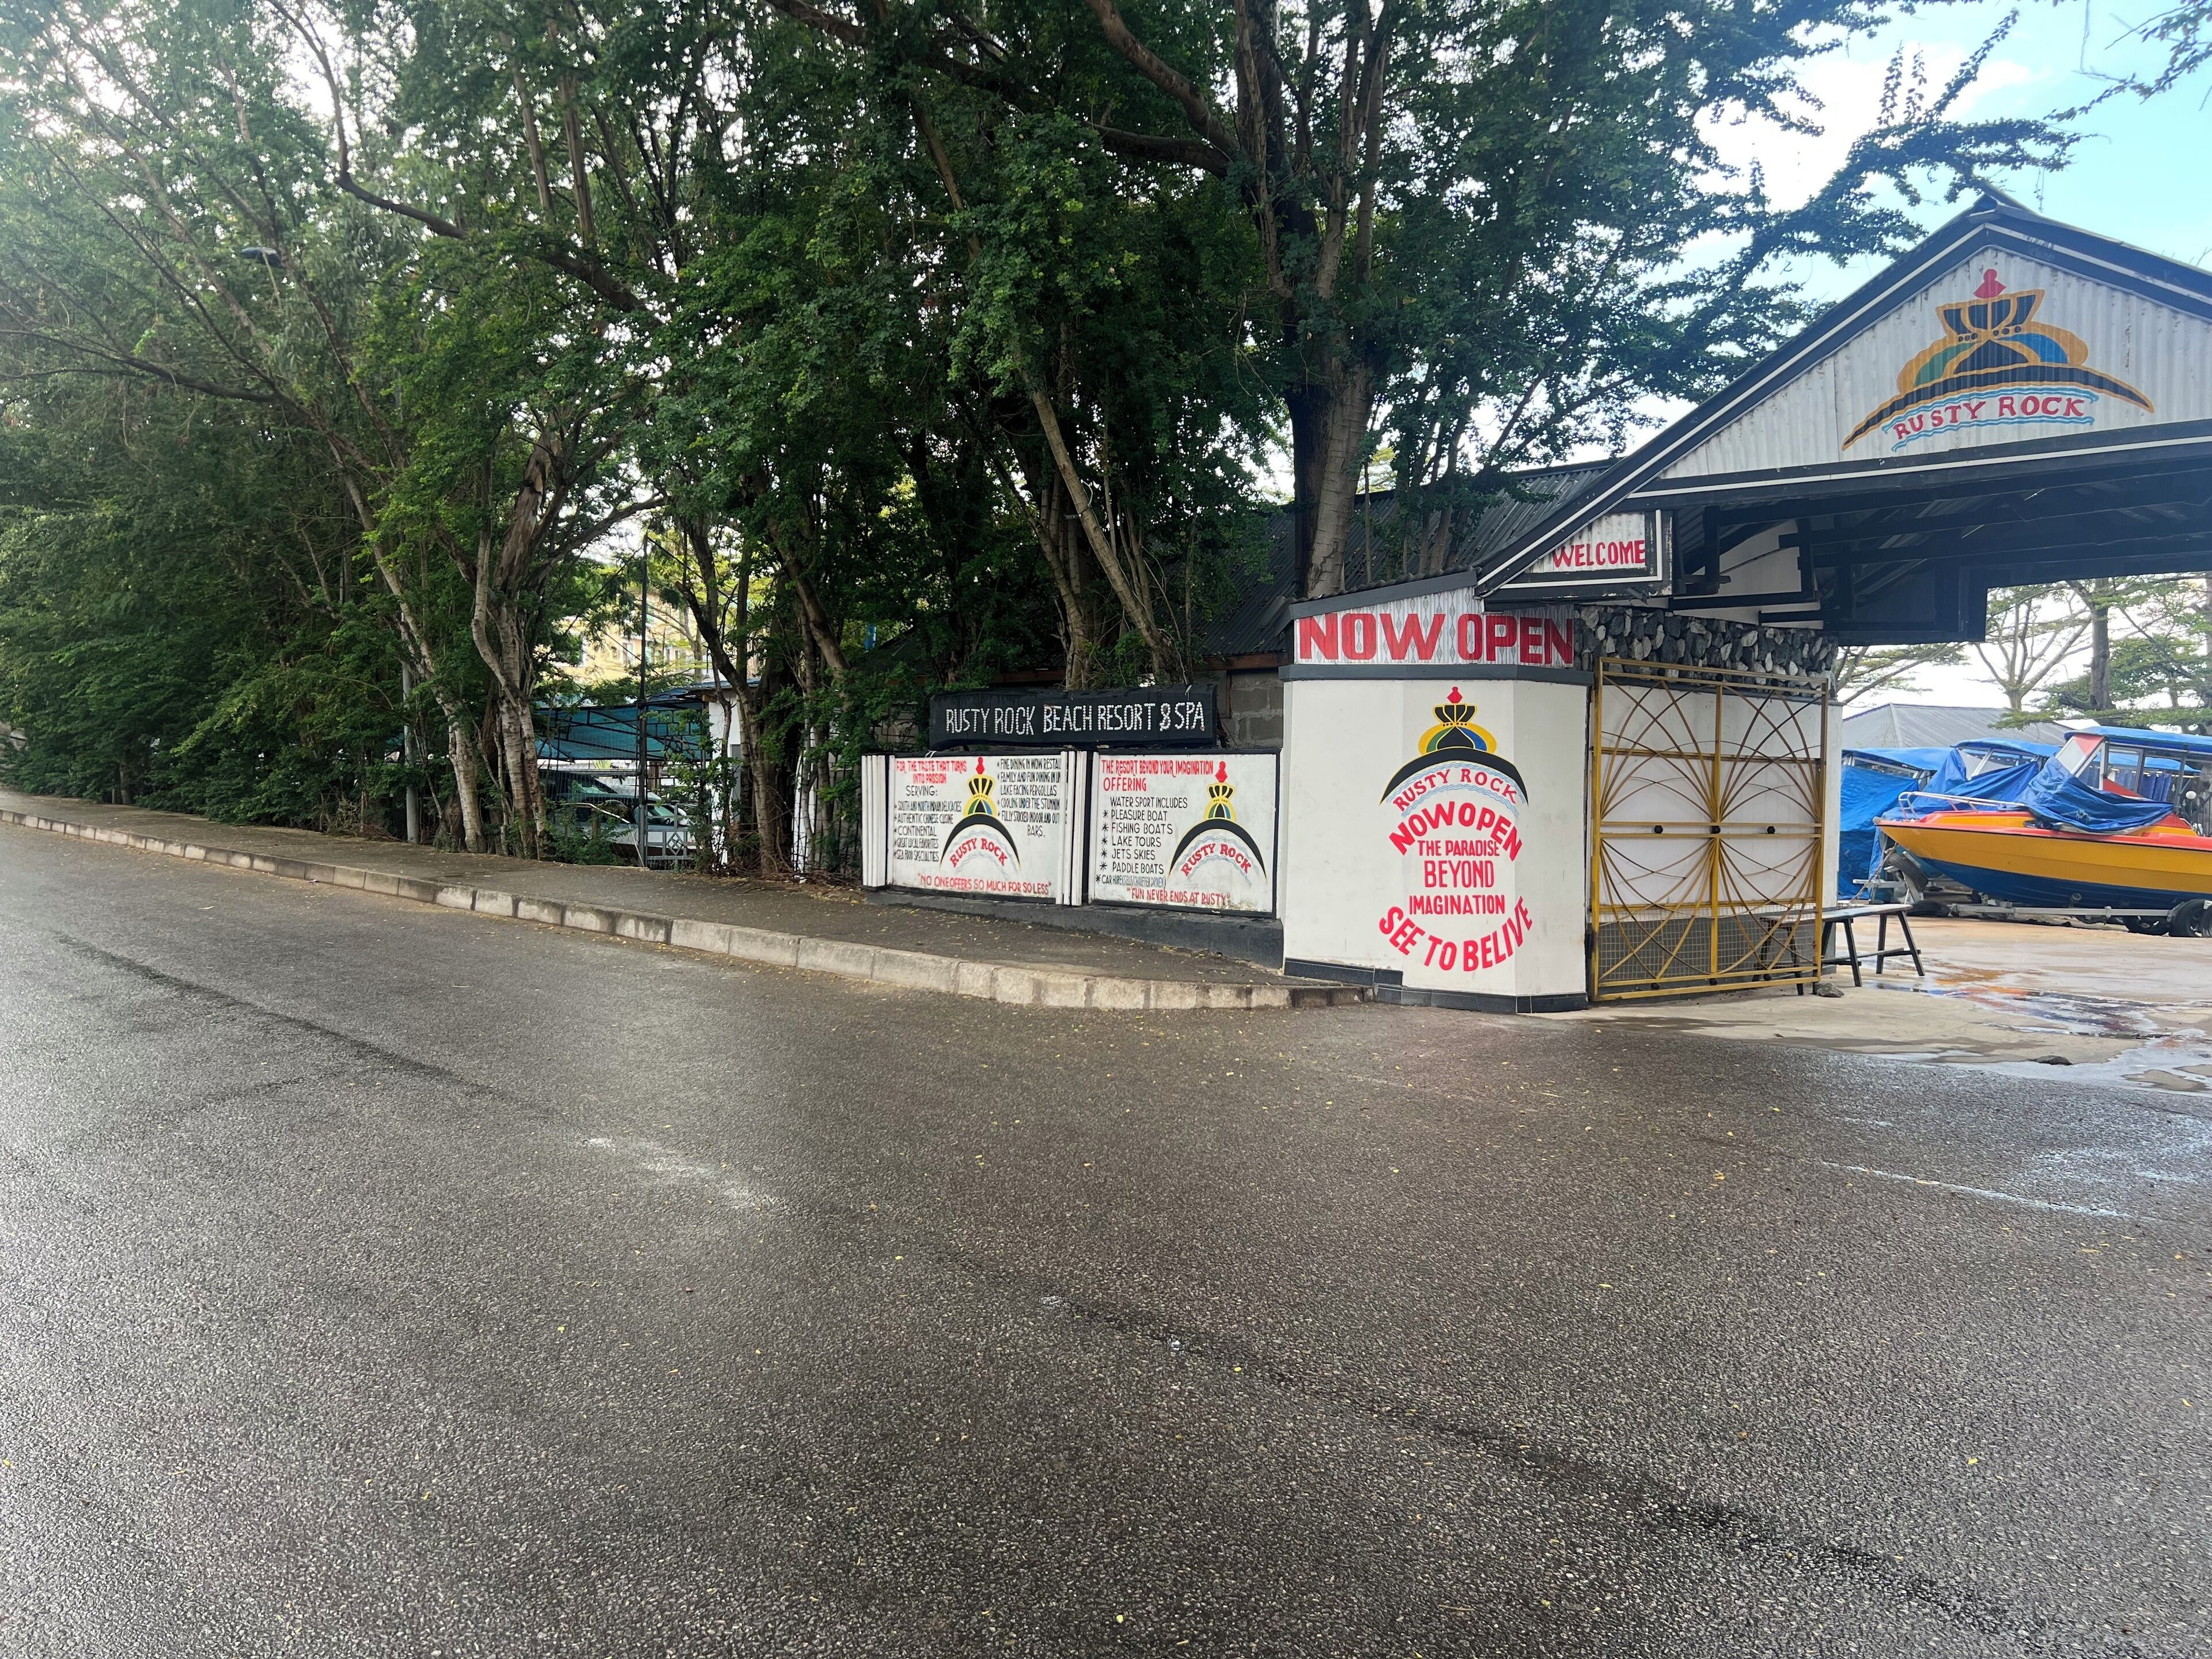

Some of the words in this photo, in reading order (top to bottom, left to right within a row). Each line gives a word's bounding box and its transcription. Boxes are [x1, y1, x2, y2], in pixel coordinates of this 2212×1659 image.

[1892, 400, 1986, 440] RUSTY
[1998, 396, 2085, 417] ROCK
[1552, 539, 1646, 568] WELCOME
[1299, 613, 1446, 661] NOW
[1457, 613, 1574, 664] OPEN
[946, 707, 990, 733] RUSTY
[994, 706, 1036, 735] ROCK
[1043, 704, 1093, 733] BEACH
[1098, 703, 1156, 731] RESORT
[1175, 702, 1206, 732] SPA
[896, 760, 907, 773] FOR
[907, 760, 917, 771] THE
[918, 760, 935, 772] TASTE
[935, 760, 950, 772] THAT
[951, 760, 967, 774] TURNS
[1001, 759, 1009, 770] FINE
[1010, 759, 1025, 770] DINING
[1026, 759, 1031, 770] IN
[1031, 759, 1043, 770] WOW
[1101, 760, 1113, 774] THE
[1116, 760, 1139, 777] RESORT
[1139, 760, 1159, 774] BEYOND
[1160, 760, 1176, 778] YOUR
[1176, 760, 1214, 775] IMAGINATION
[913, 774, 925, 784] INTO
[926, 774, 946, 784] PASSION
[1001, 772, 1017, 782] FAMILY
[1017, 772, 1027, 782] AND
[1028, 772, 1036, 782] FUN
[1037, 772, 1050, 783] DINING
[1103, 777, 1147, 791] OFFERING
[906, 785, 938, 797] SERVING:
[1001, 785, 1013, 796] LAKE
[1014, 785, 1029, 796] FACING
[1030, 785, 1057, 797] PERGOLLAS
[1393, 769, 1450, 812] RUSTY
[1460, 768, 1517, 804] ROCK
[1001, 797, 1017, 808] COOLING
[1018, 798, 1030, 809] UNDER
[1031, 798, 1040, 809] THE
[1110, 797, 1134, 808] WATER
[1135, 797, 1156, 808] SPORT
[1156, 797, 1188, 809] INCLUDES
[897, 813, 922, 823] AUTHENTIC
[923, 813, 939, 824] CHINESE
[1001, 810, 1013, 821] FULLY
[1014, 811, 1029, 823] STOCKED
[1029, 811, 1043, 824] INDOOR
[1111, 809, 1145, 821] PLEASURE
[1147, 810, 1168, 821] BOAT
[898, 825, 937, 836] CONTINENTAL
[1111, 822, 1140, 834] FISHING
[1143, 823, 1173, 834] BOATS
[1389, 801, 1455, 856] NOW
[1458, 802, 1522, 862] OPEN
[897, 838, 907, 848] GREAT
[908, 838, 919, 849] LOCAL
[1112, 835, 1132, 847] LAKE
[1135, 836, 1161, 847] TOURS
[950, 838, 978, 868] RUSTY
[981, 838, 1007, 866] ROCK
[1112, 849, 1131, 859] JETS
[1134, 849, 1156, 860] SKIES
[1417, 840, 1441, 856] THE
[1445, 840, 1500, 857] PARADISE
[1181, 843, 1215, 877] RUSTY
[1219, 843, 1252, 874] ROCK
[1112, 861, 1139, 873] PADDLE
[1141, 863, 1164, 874] BOATS
[1424, 860, 1494, 888] BEYOND
[934, 876, 949, 888] ONE
[950, 877, 972, 890] OFFERS
[974, 879, 984, 891] SO
[987, 880, 1006, 892] MUCH
[1009, 881, 1021, 892] FOR
[1023, 881, 1032, 893] SO
[1101, 874, 1112, 885] CAR
[1147, 889, 1168, 902] NEVER
[1170, 891, 1188, 904] ENDS
[1190, 892, 1199, 905] AT
[1409, 895, 1505, 915] IMAGINATION
[1379, 906, 1426, 956] SEE
[1424, 934, 1457, 971] TO
[1463, 896, 1533, 972] BELIVE
